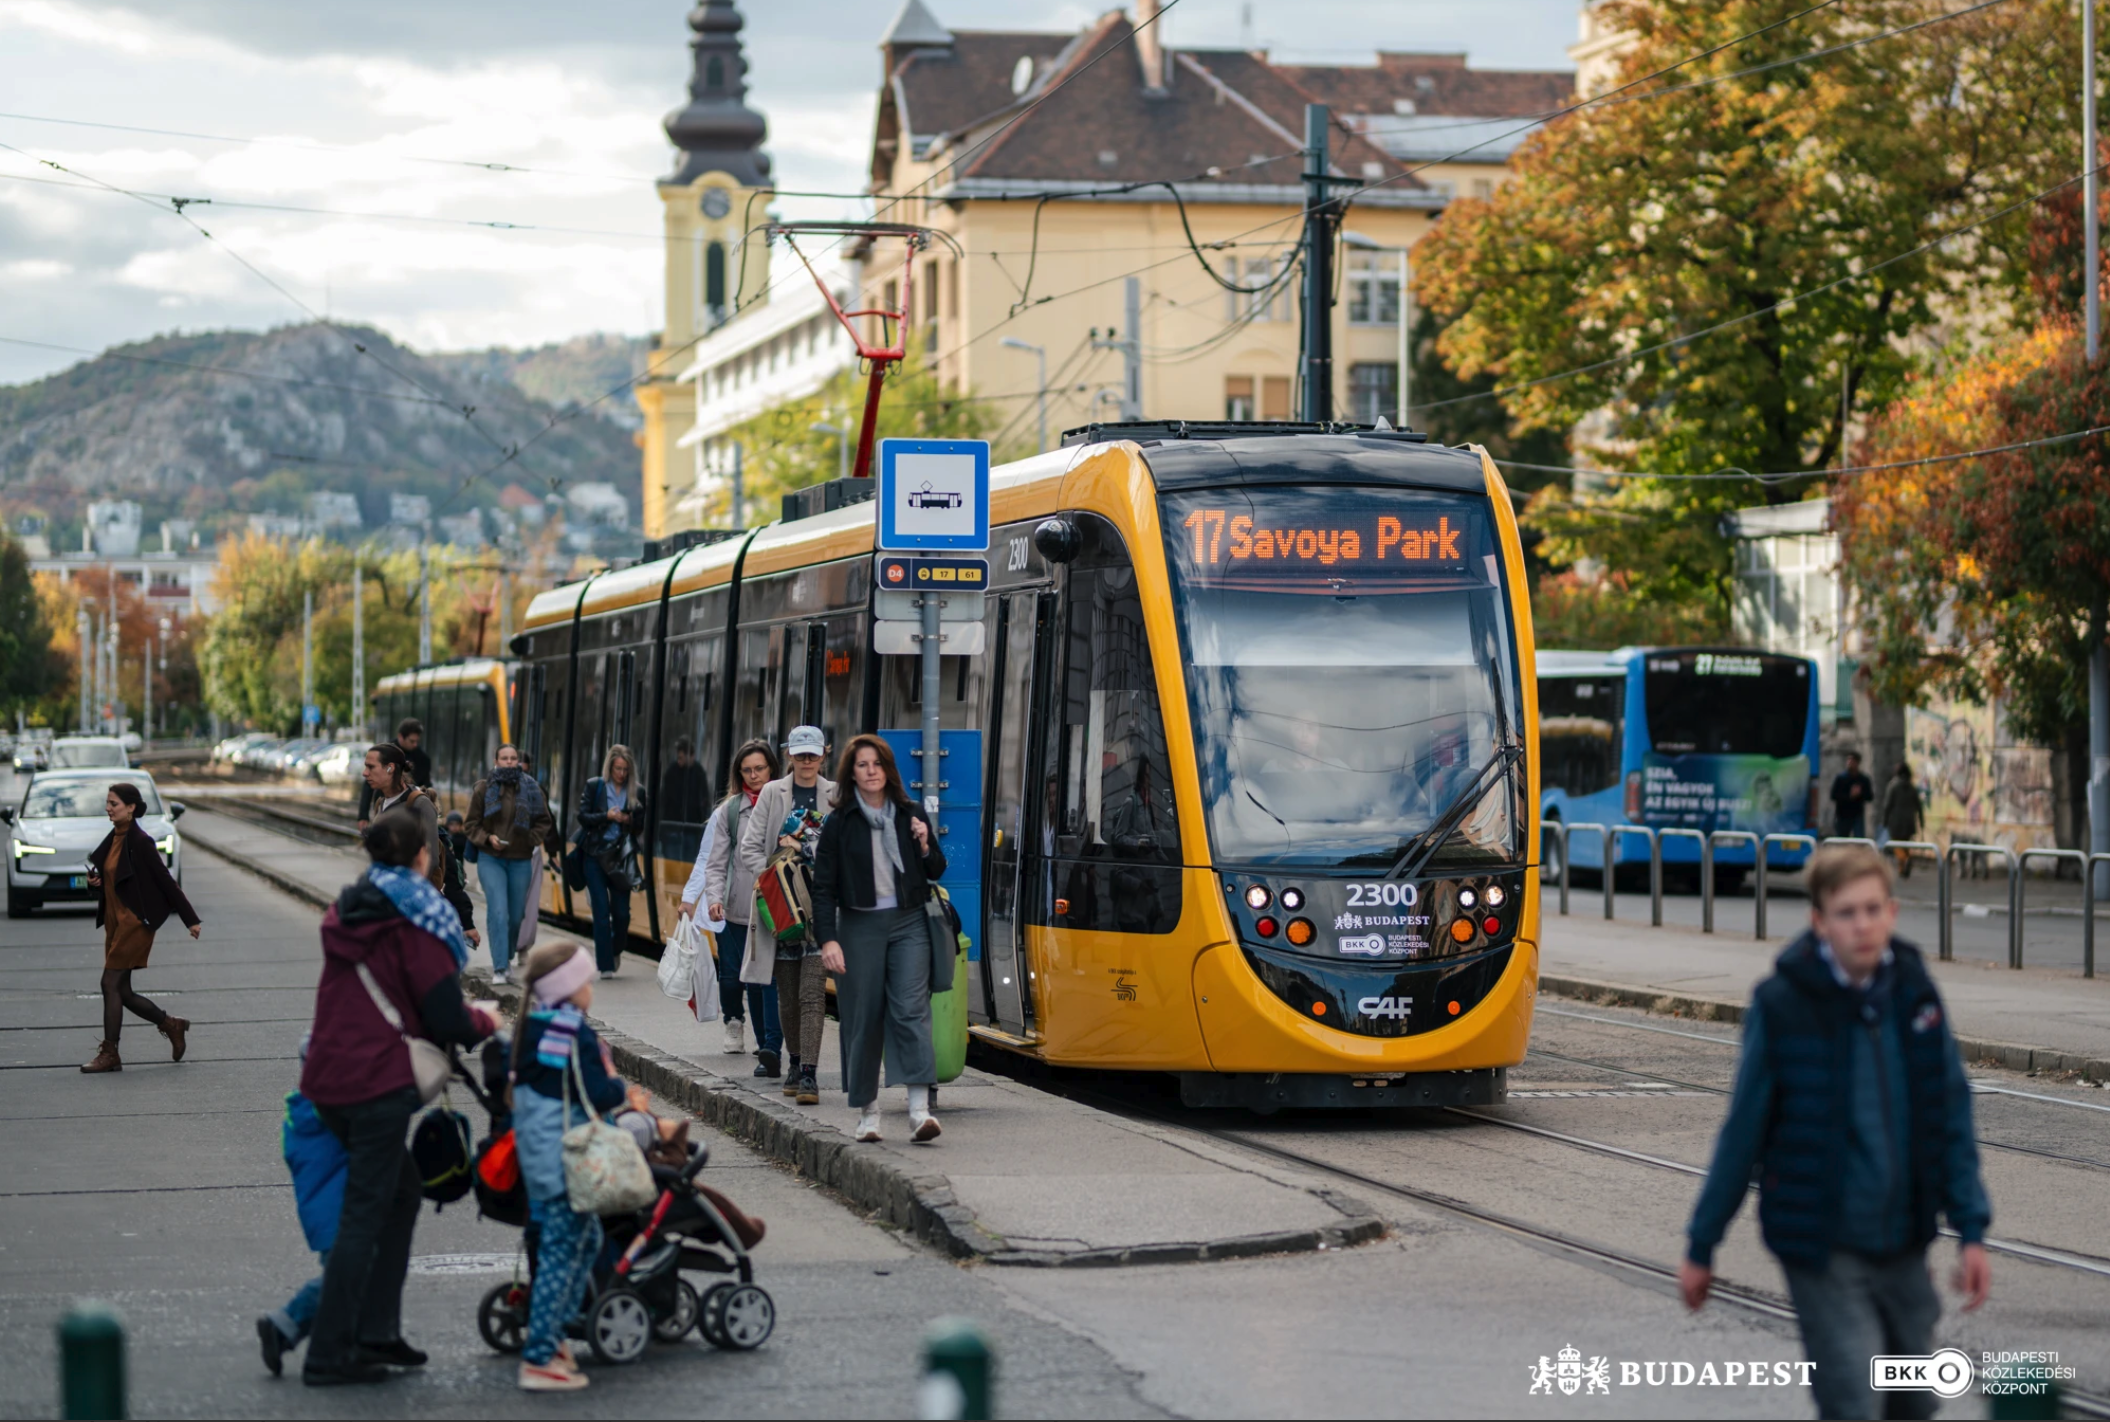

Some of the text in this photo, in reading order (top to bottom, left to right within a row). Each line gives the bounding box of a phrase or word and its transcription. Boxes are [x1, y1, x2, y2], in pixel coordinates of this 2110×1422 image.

[1185, 510, 1460, 564] 17 Savoya Park
[1008, 536, 1028, 571] 2300
[888, 569, 902, 578] D4
[1345, 883, 1418, 906] 2300
[1364, 915, 1430, 926] BUDAPEST
[1358, 996, 1413, 1019] CAF
